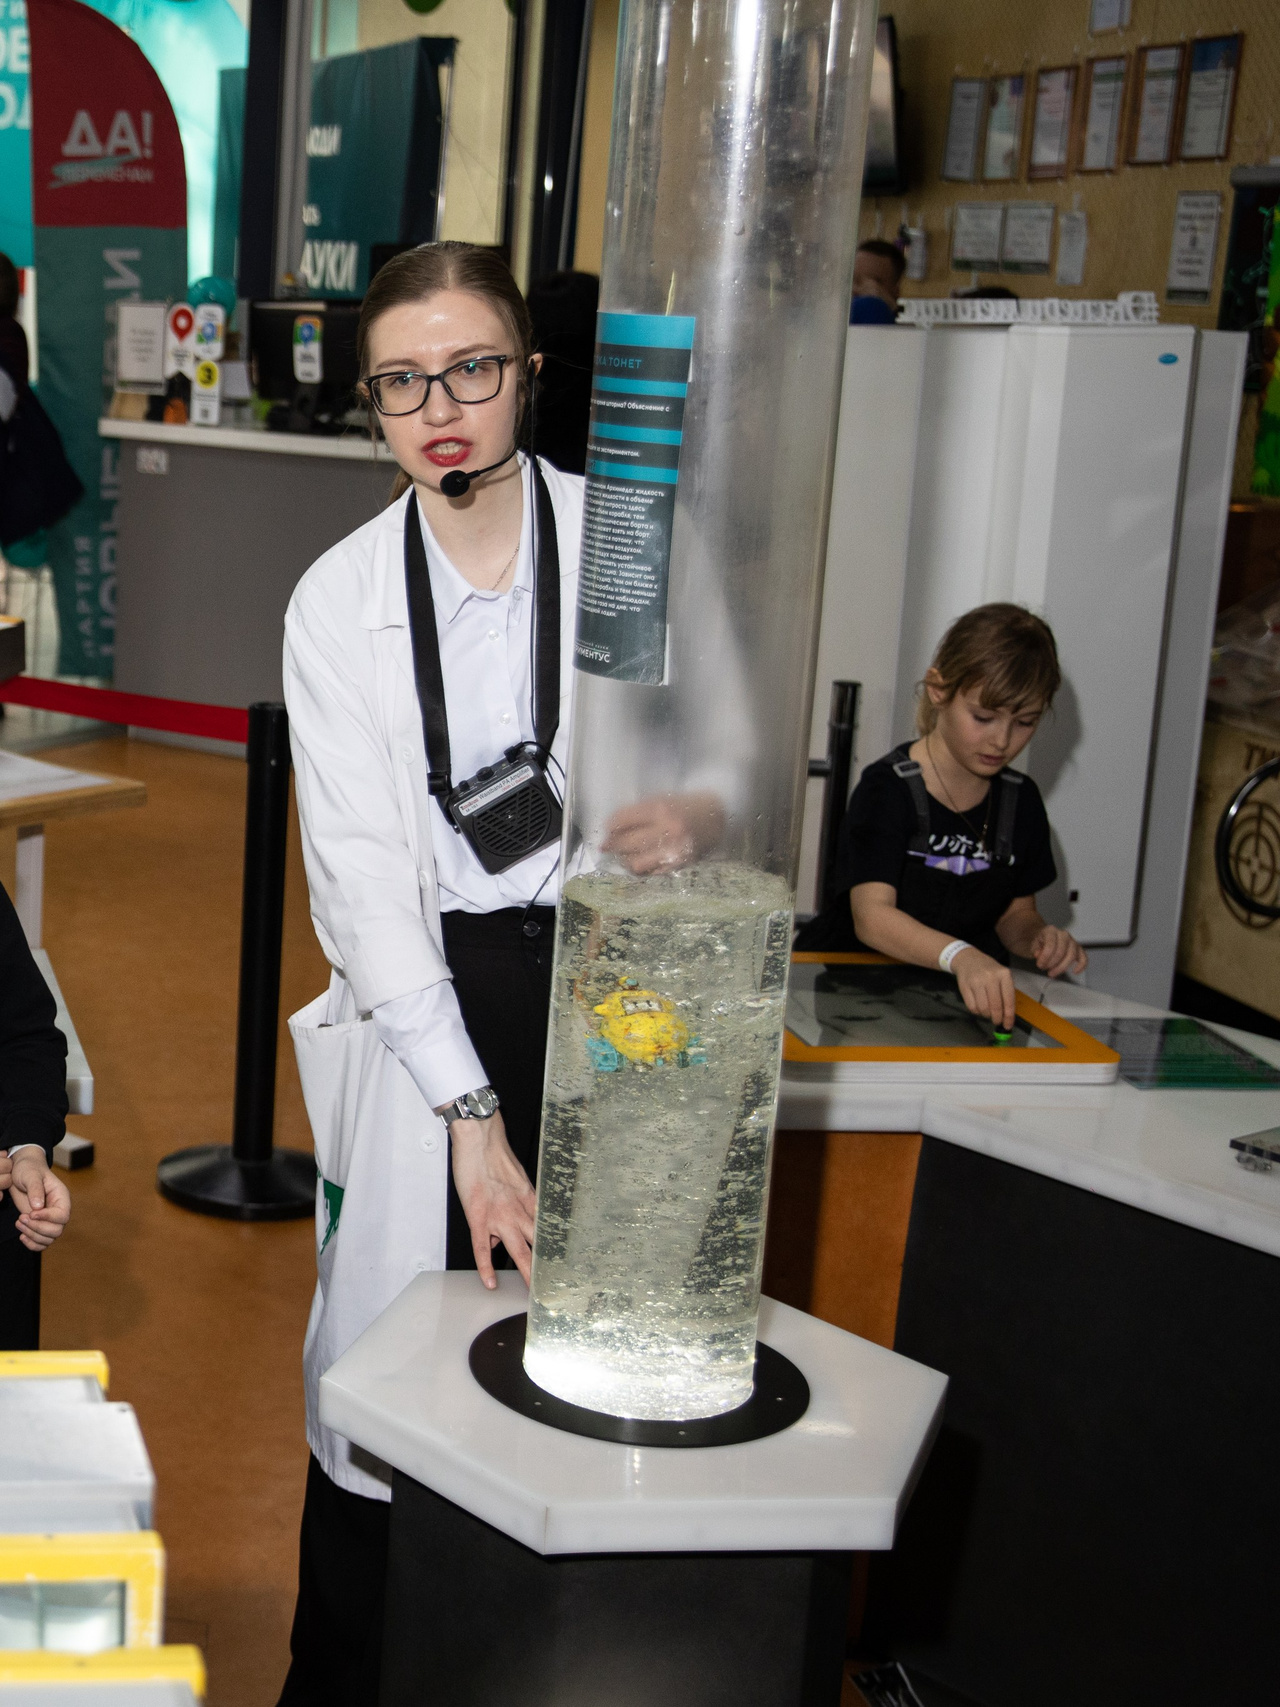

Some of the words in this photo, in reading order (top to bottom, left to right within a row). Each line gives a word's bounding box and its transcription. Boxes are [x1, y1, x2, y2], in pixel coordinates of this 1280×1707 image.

[61, 110, 153, 158] ДА!
[299, 240, 359, 292] АУКИ
[608, 356, 643, 369] ТОНЕТ
[627, 402, 664, 411] Объяснение
[607, 484, 634, 493] Архимеда:
[635, 489, 665, 497] жидкость
[630, 521, 649, 530] борта
[617, 562, 652, 572] устойчивое
[619, 570, 641, 579] Зависит
[613, 577, 624, 585] Чем
[633, 581, 653, 589] ближе
[631, 590, 657, 598] меньше
[480, 782, 502, 799] Waistband
[502, 778, 511, 786] PA
[510, 767, 530, 782] Amplifier
